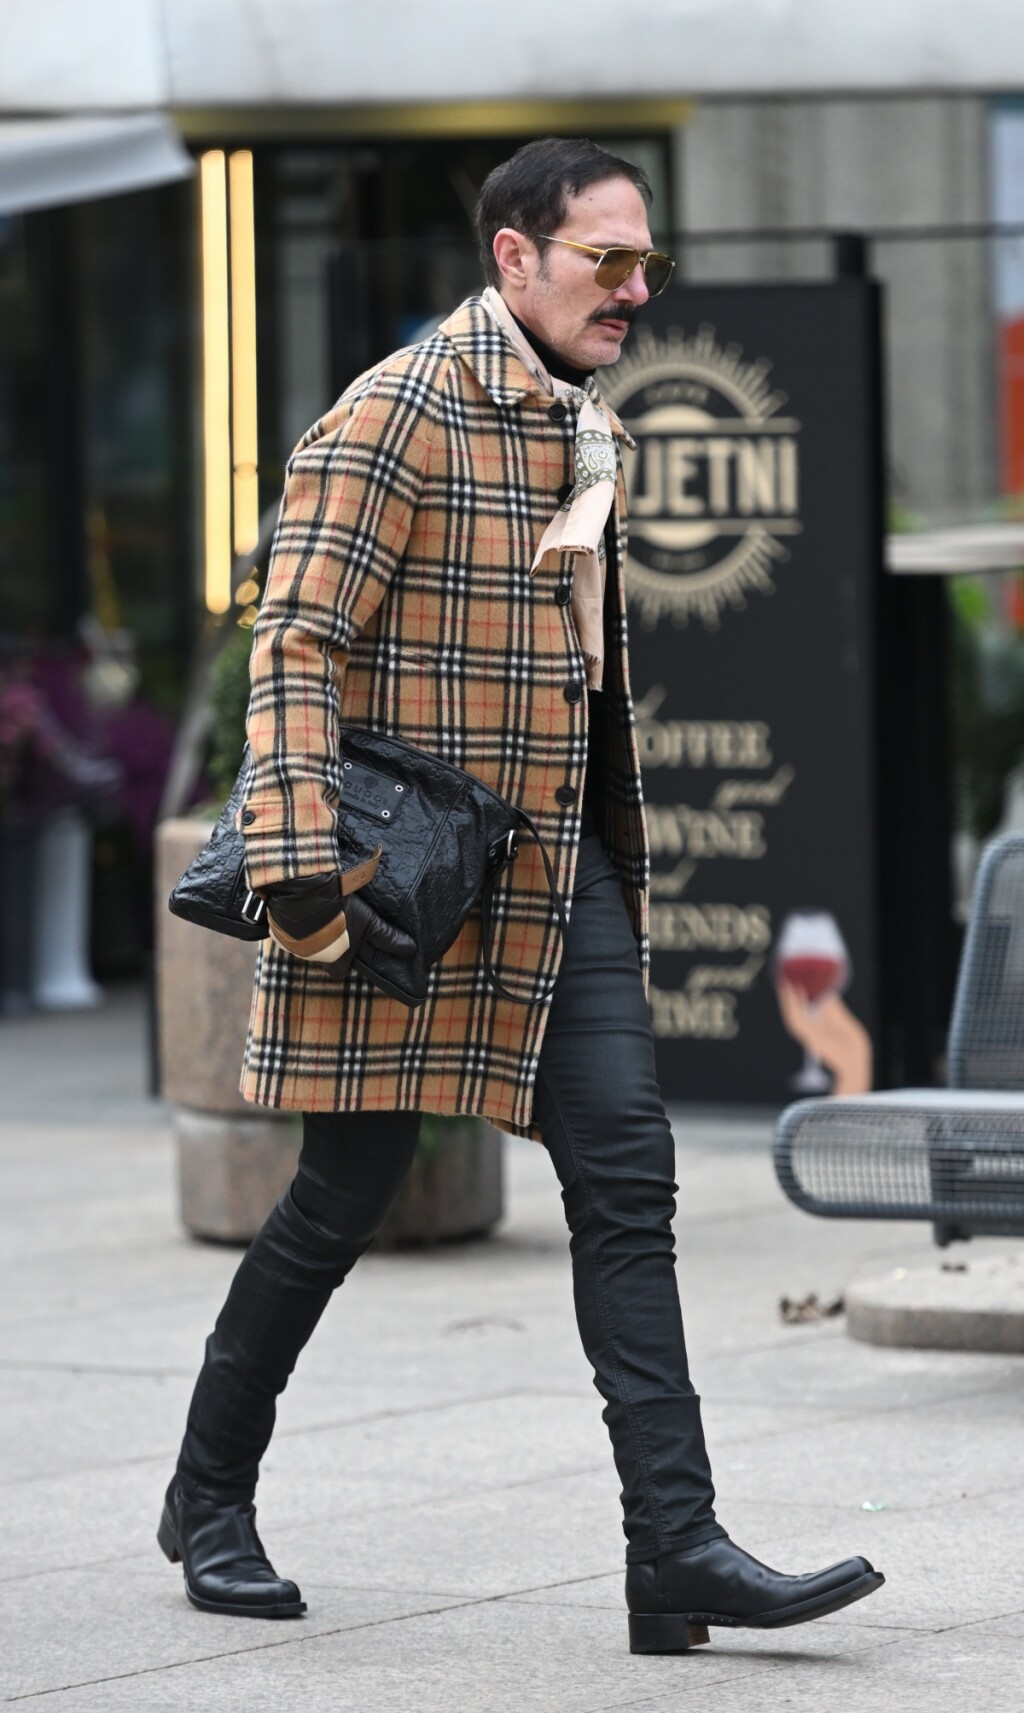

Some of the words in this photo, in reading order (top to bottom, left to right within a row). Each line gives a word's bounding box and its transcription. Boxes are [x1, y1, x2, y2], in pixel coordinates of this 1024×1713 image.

[628, 437, 797, 514] JETNI
[634, 721, 772, 768] OFFEE
[344, 781, 388, 805] GUCCI
[650, 903, 772, 952] IENDS
[650, 985, 740, 1040] IME
